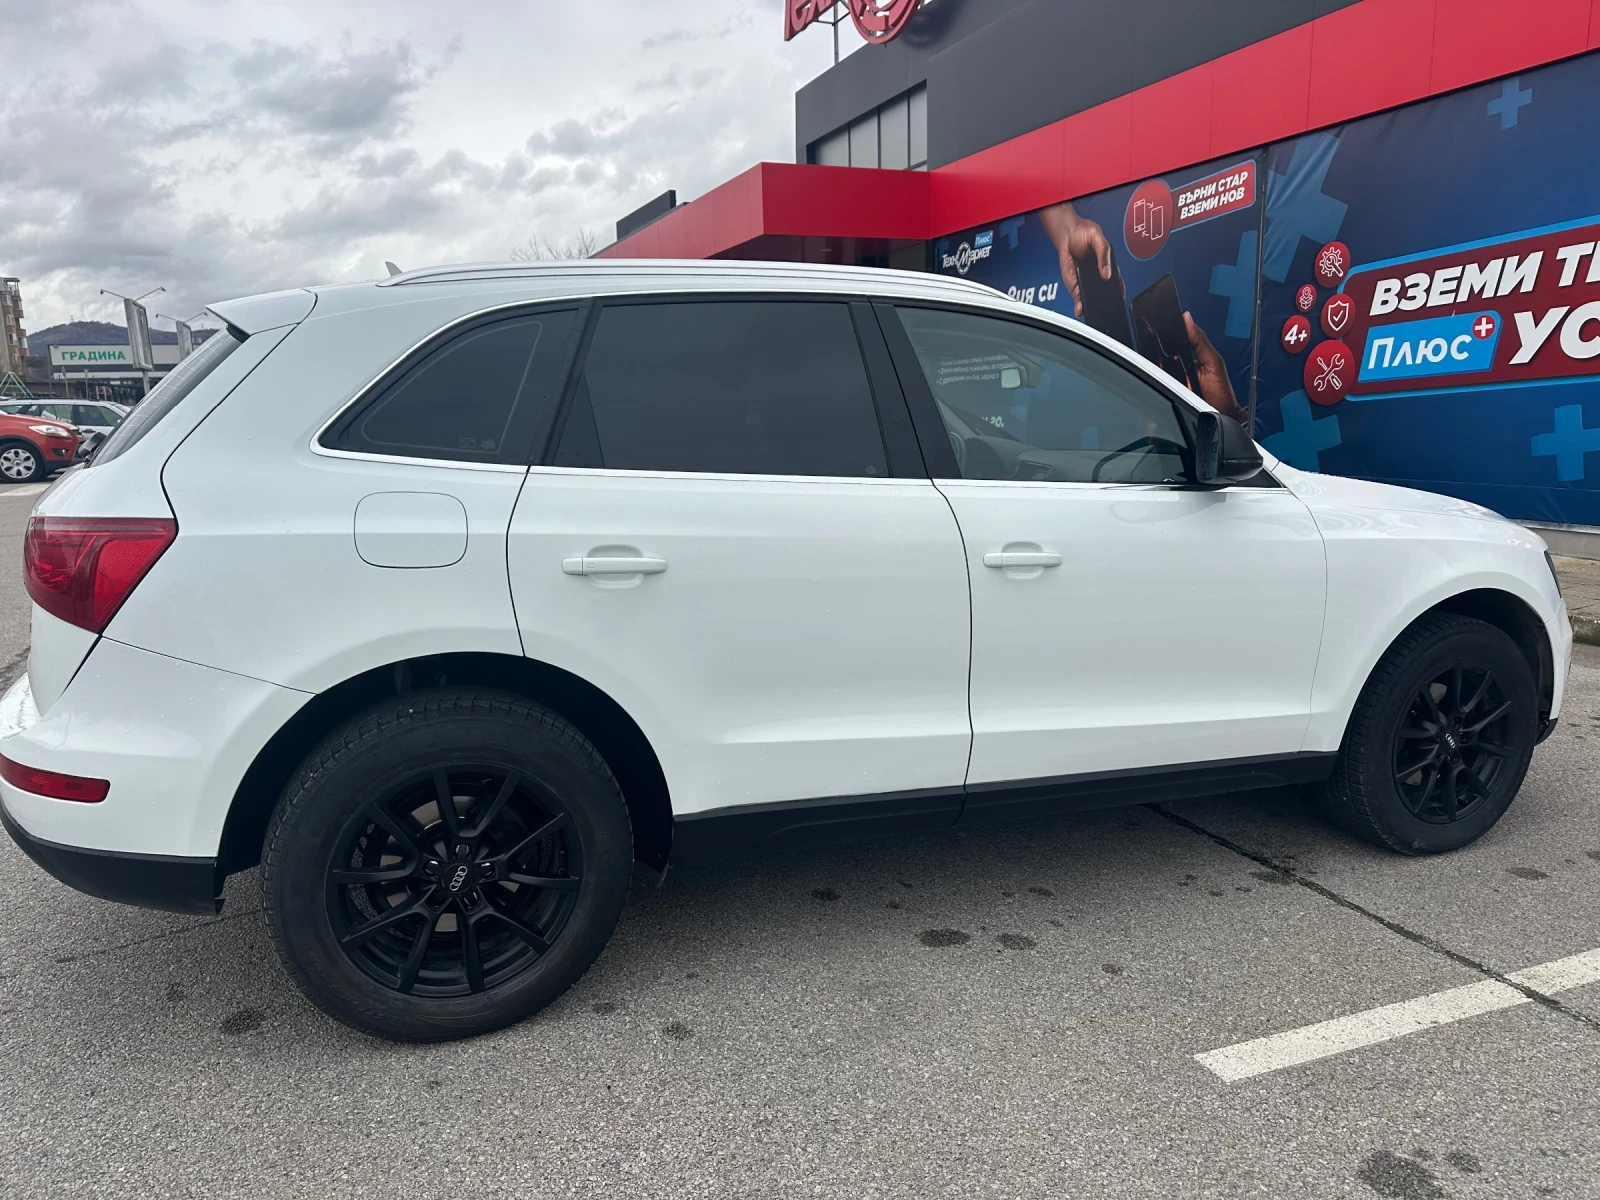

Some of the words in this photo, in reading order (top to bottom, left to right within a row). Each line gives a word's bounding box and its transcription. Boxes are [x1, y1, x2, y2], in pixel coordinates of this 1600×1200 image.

[1177, 182, 1217, 207] ВЪРНИ
[1218, 171, 1249, 192] СТАР
[1180, 196, 1219, 220] ВЗЕМИ
[1219, 187, 1245, 206] НОВ
[1369, 251, 1544, 316] ВЗЕМИ
[1284, 324, 1308, 344] 4+
[1508, 300, 1600, 365] УС
[61, 350, 126, 362] ГРАДИНА
